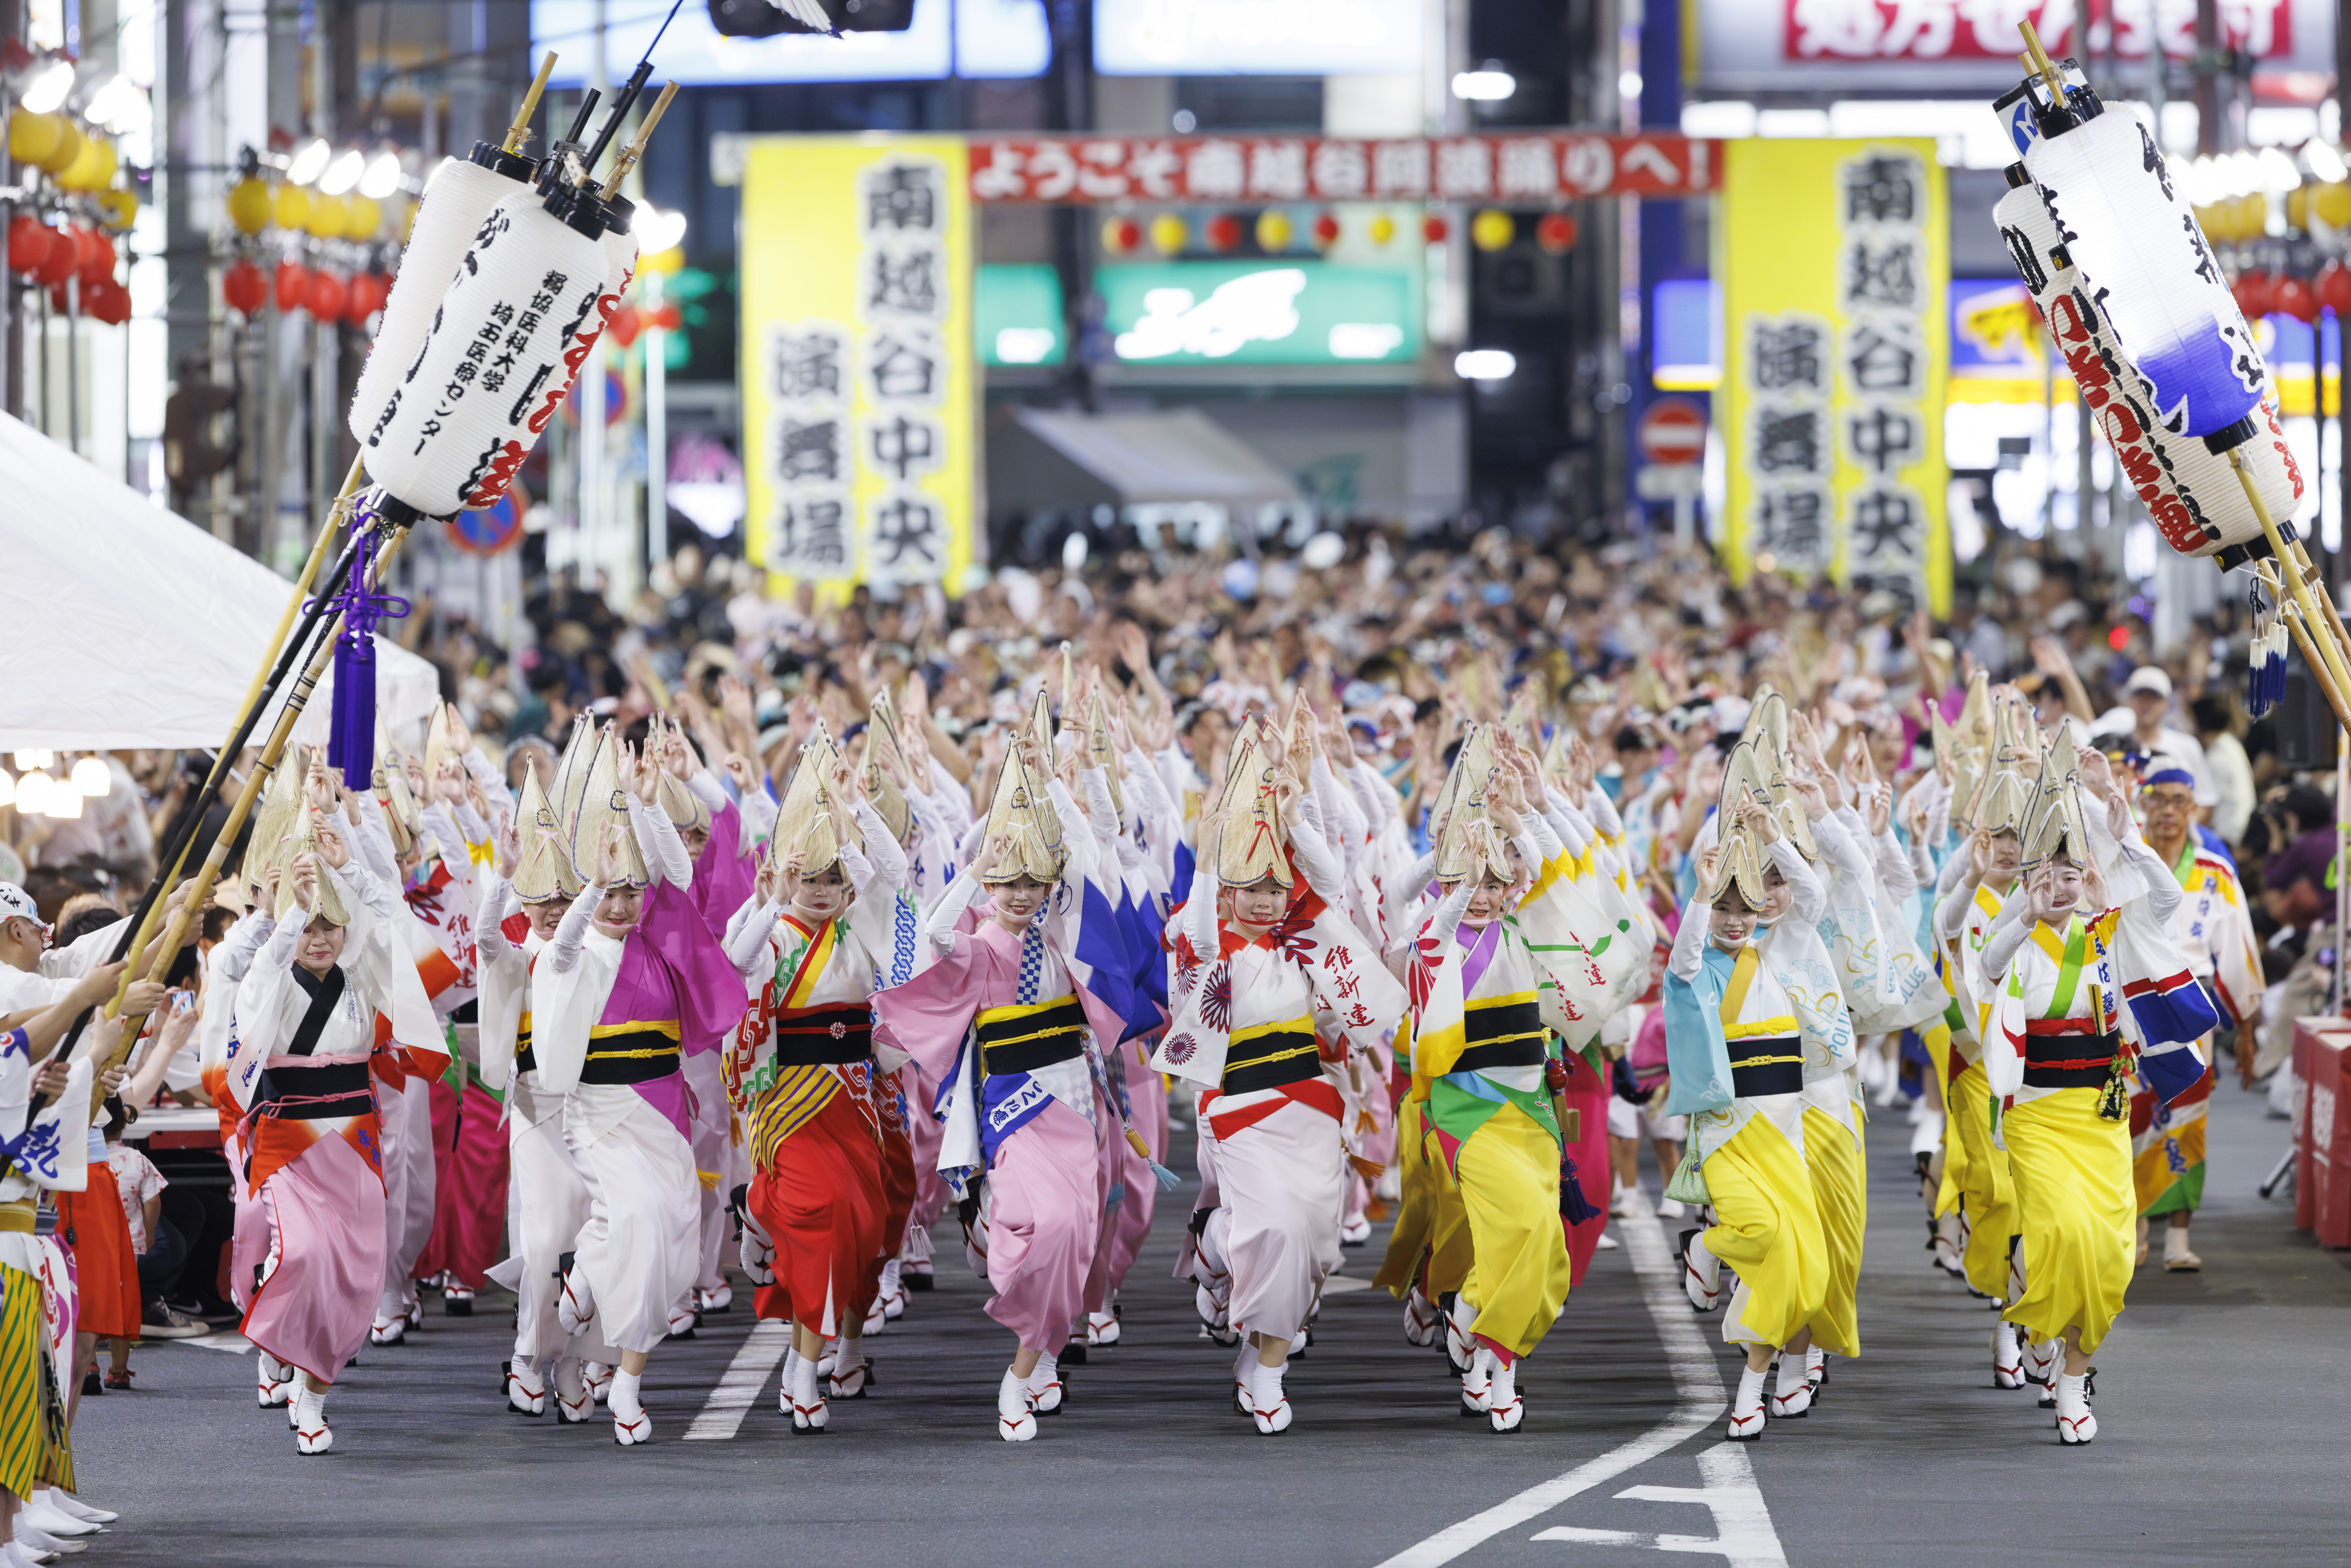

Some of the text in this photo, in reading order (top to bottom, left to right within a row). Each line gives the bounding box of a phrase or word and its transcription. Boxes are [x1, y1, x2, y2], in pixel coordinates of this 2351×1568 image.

[413, 299, 516, 456] 埼玉医療センター
[1324, 945, 1375, 1029] 維新連
